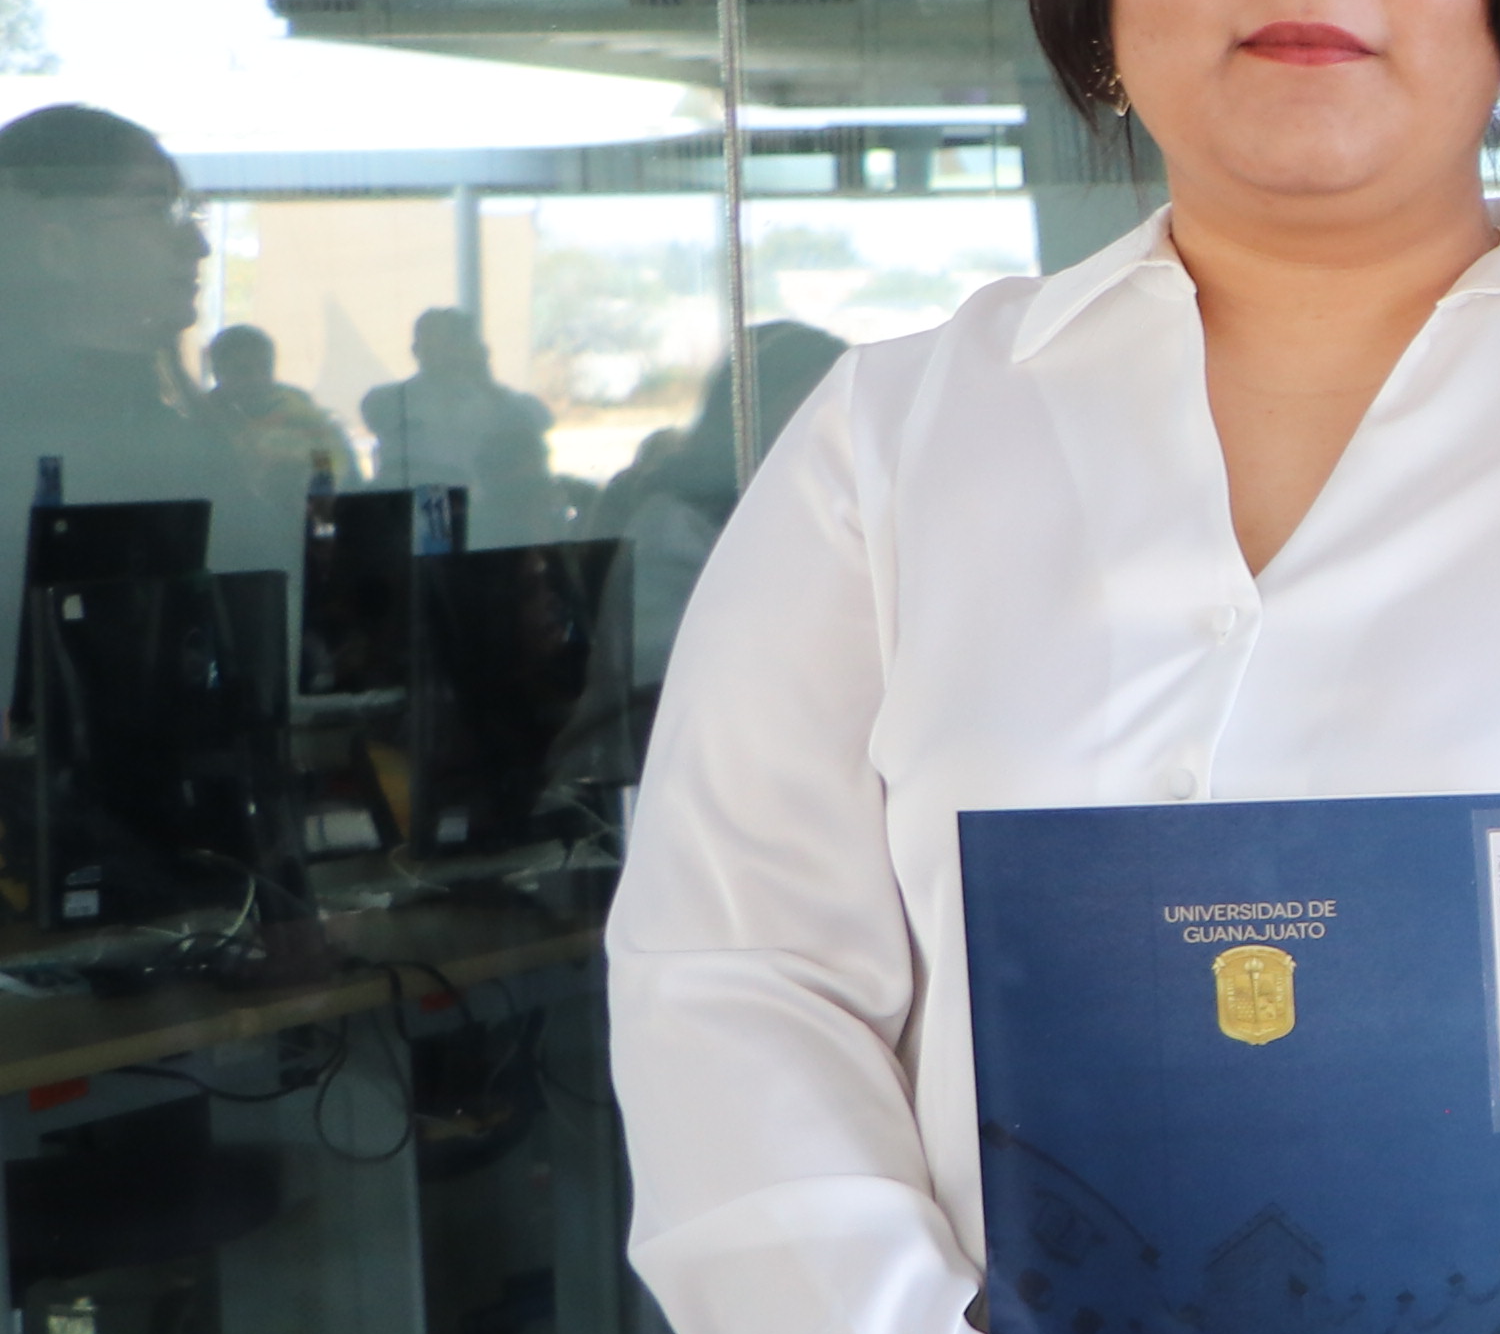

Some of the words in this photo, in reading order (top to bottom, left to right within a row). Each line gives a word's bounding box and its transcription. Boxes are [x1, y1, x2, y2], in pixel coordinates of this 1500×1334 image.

[1164, 901, 1303, 923] UNIVERSIDAD
[1308, 900, 1337, 917] DE
[1183, 921, 1326, 943] GUANAJUATO
